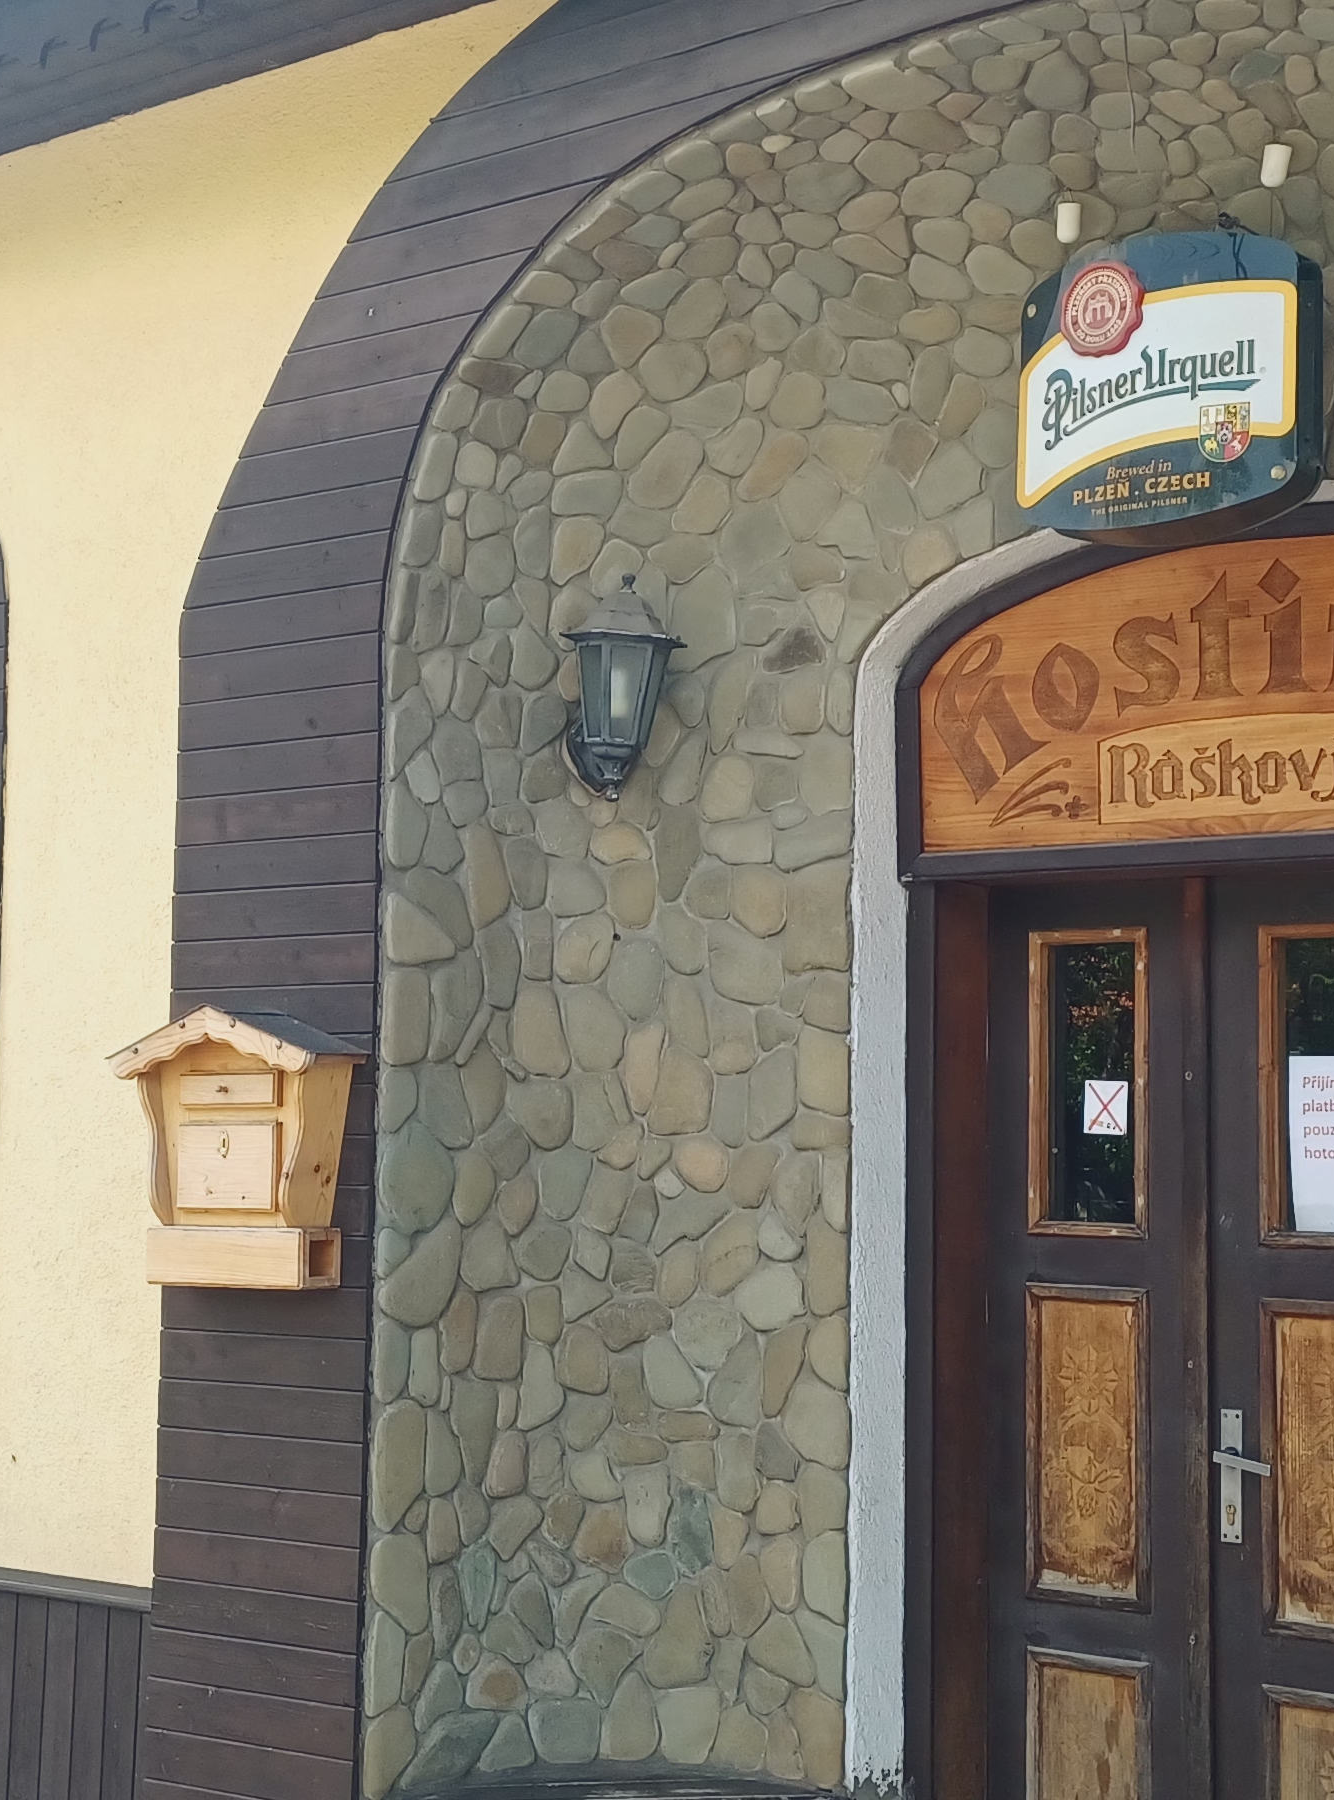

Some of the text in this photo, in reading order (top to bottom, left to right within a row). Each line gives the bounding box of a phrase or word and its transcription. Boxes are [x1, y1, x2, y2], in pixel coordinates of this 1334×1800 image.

[1042, 339, 1256, 451] Pilsner Urquell
[1106, 459, 1172, 480] Brewed in
[1073, 471, 1211, 506] PLZEŇ CZECH
[1091, 496, 1188, 516] THE ORIGINAL PILSNER
